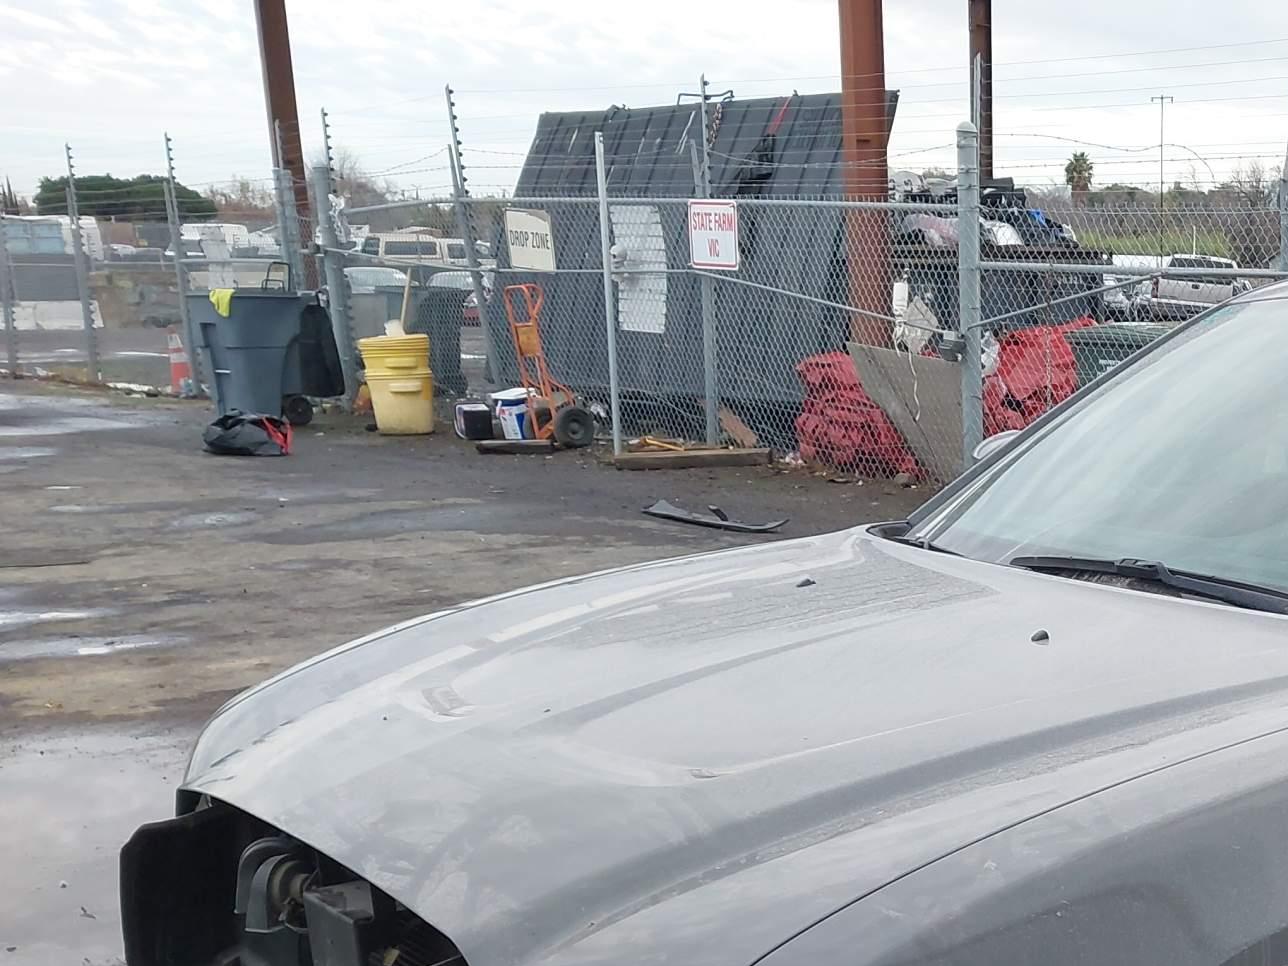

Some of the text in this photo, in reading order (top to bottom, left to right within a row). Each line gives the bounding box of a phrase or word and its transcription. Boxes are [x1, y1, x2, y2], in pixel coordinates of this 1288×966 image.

[693, 213, 733, 232] STATE FARM
[510, 230, 550, 250] DROP ZONE
[708, 239, 720, 258] VIC
